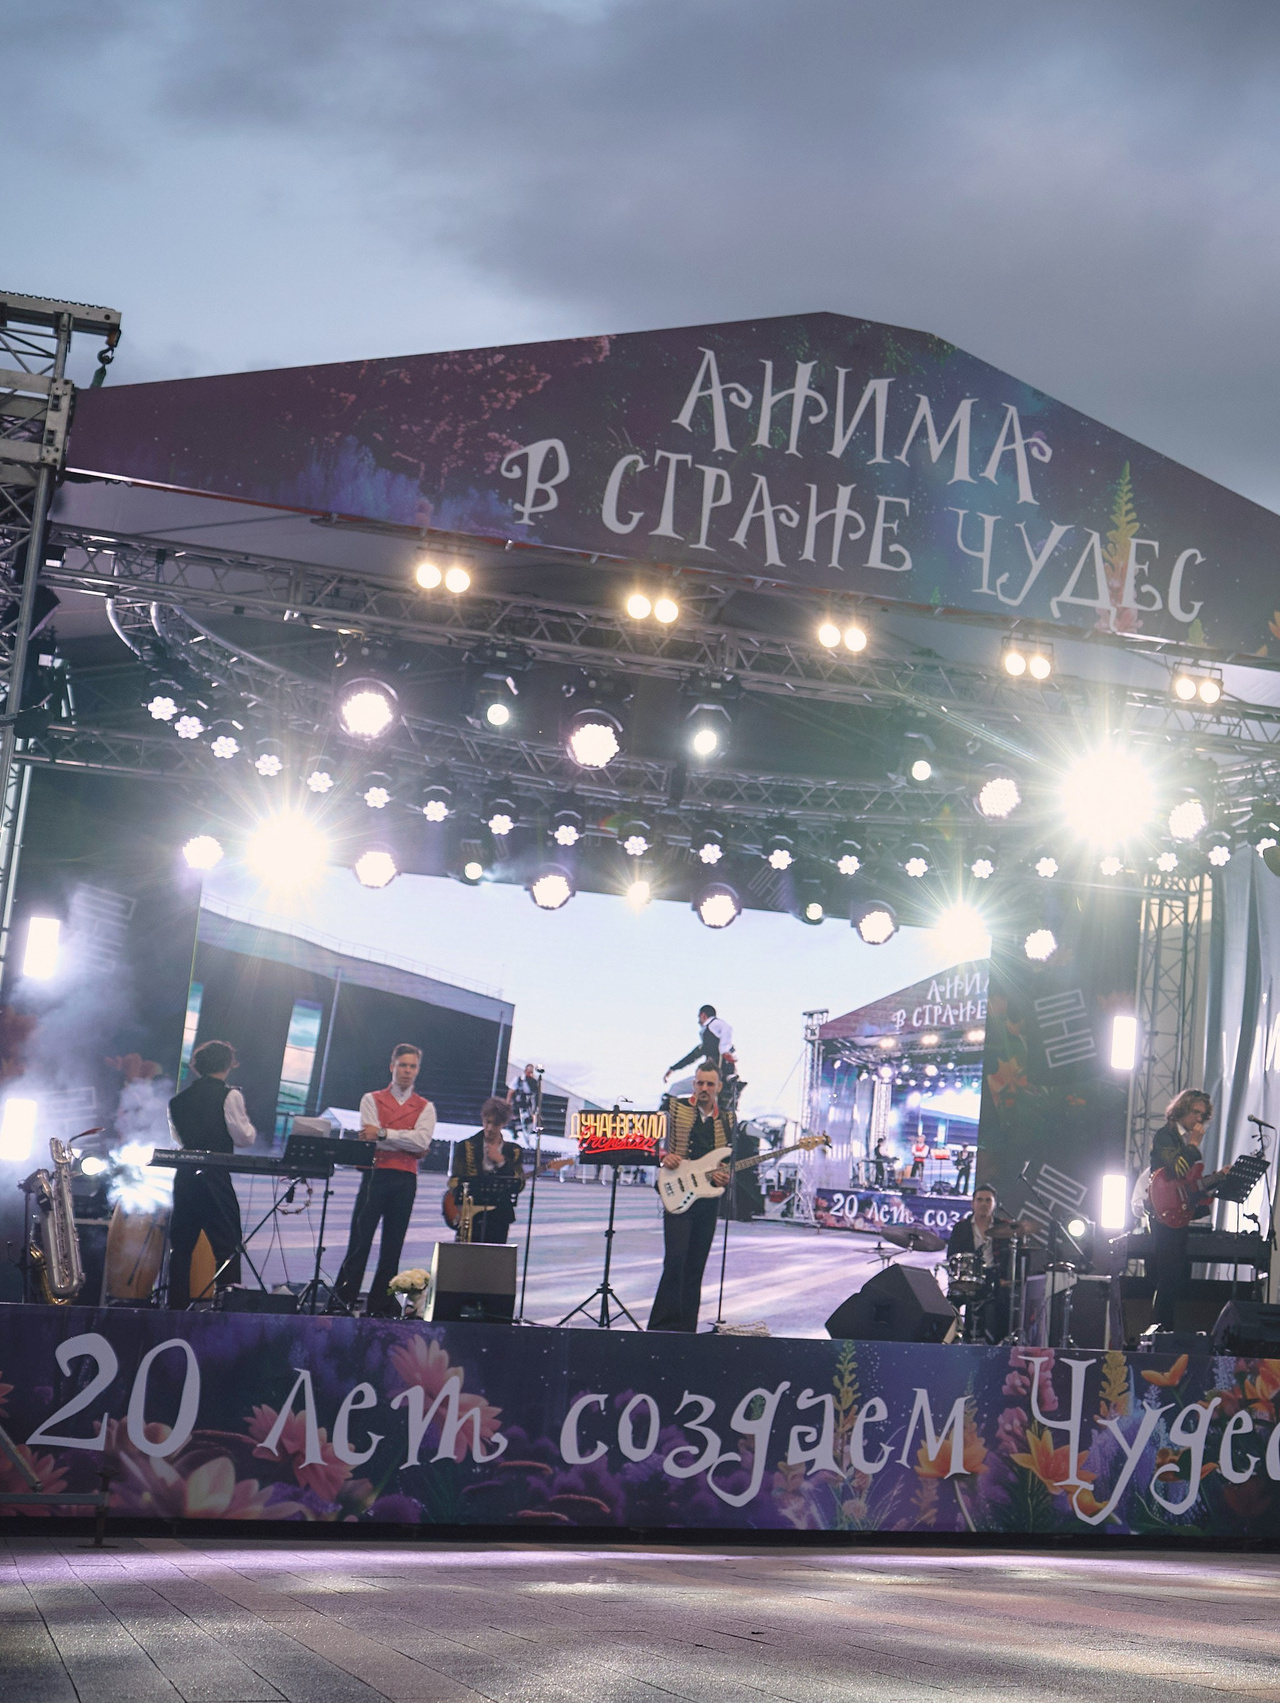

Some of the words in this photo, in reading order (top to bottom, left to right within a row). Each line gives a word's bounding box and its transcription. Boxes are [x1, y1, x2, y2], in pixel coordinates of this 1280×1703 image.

[672, 346, 1053, 505] АНИМА
[501, 438, 570, 525] В
[600, 450, 914, 572] СТРАНЕ
[948, 507, 1207, 631] ЧУДЕС
[927, 972, 989, 1003] АНИ
[830, 1192, 858, 1218] 20
[26, 1333, 200, 1458] 20
[257, 1367, 508, 1470] лет
[560, 1380, 975, 1508] создаем
